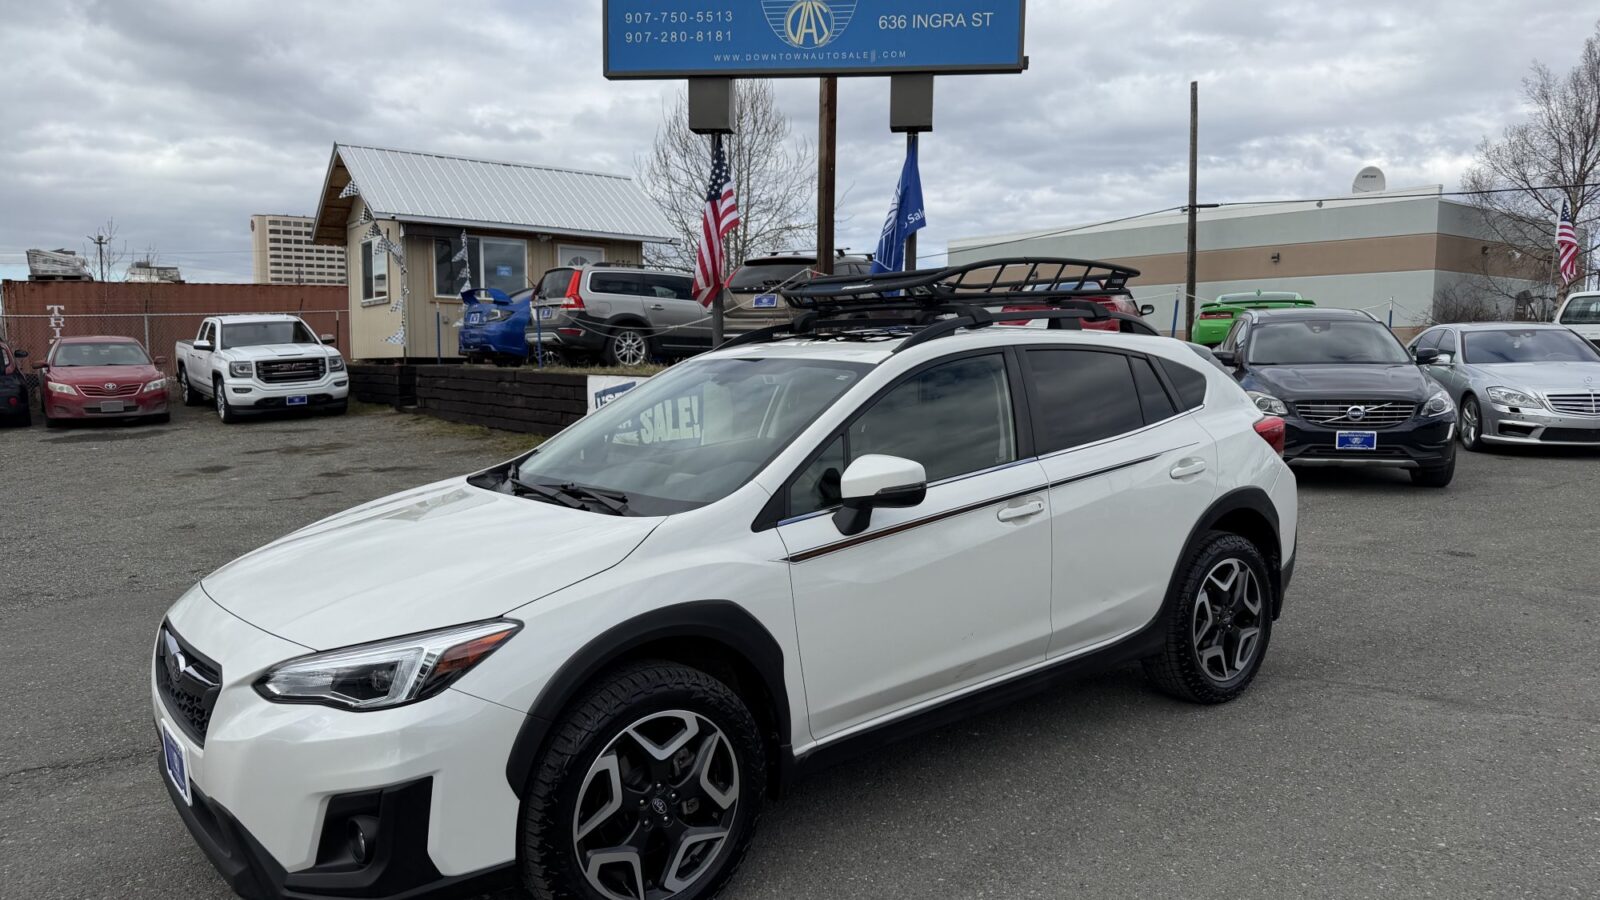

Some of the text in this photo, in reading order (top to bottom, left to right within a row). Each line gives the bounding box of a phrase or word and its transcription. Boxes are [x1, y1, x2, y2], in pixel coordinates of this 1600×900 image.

[625, 11, 733, 24] 907-750-5513
[878, 12, 994, 30] 636 INGRA ST
[625, 31, 732, 43] 907-280-8181
[713, 50, 907, 62] WWW.DOWNTOWNAUTOSALE.COM
[640, 395, 700, 444] SALE!
